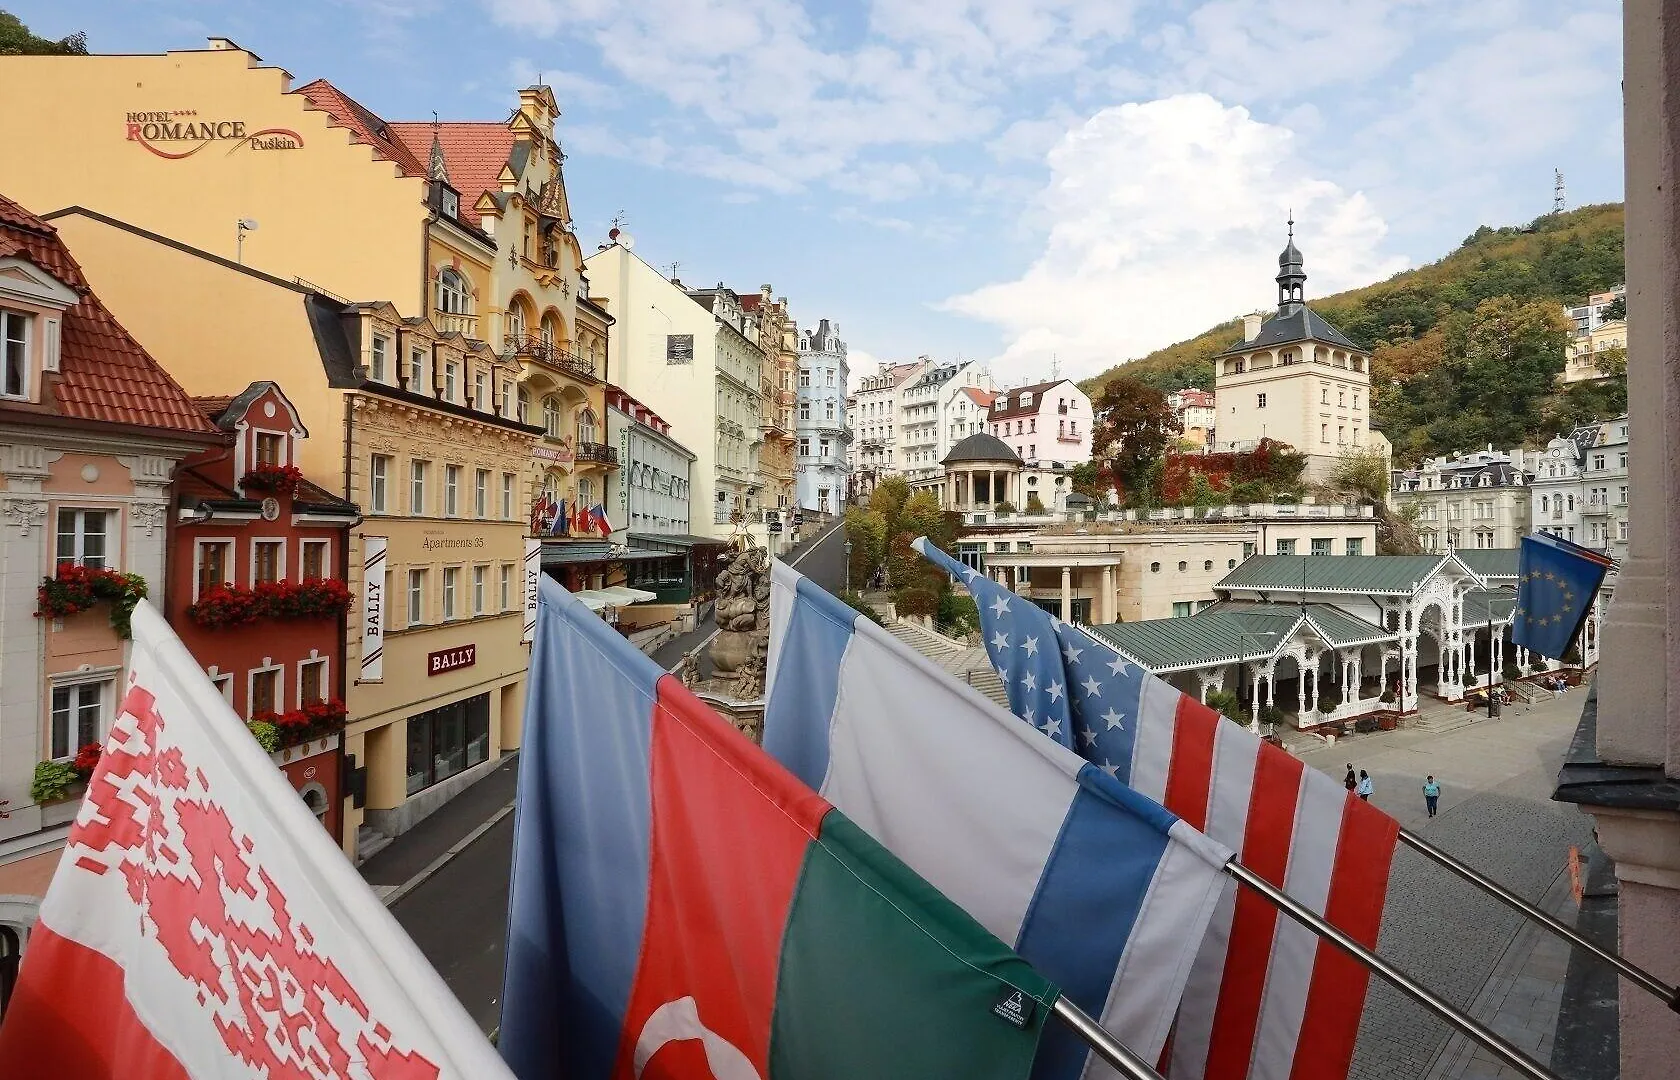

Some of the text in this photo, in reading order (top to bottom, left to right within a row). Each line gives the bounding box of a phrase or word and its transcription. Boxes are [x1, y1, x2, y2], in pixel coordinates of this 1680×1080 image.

[126, 112, 173, 123] HOTEL
[126, 121, 247, 141] ROMANCE
[251, 137, 295, 149] Puškin
[422, 537, 484, 551] Apartments 35
[528, 570, 538, 610] BALLY
[367, 581, 381, 637] BALLY
[432, 648, 474, 671] BALLY
